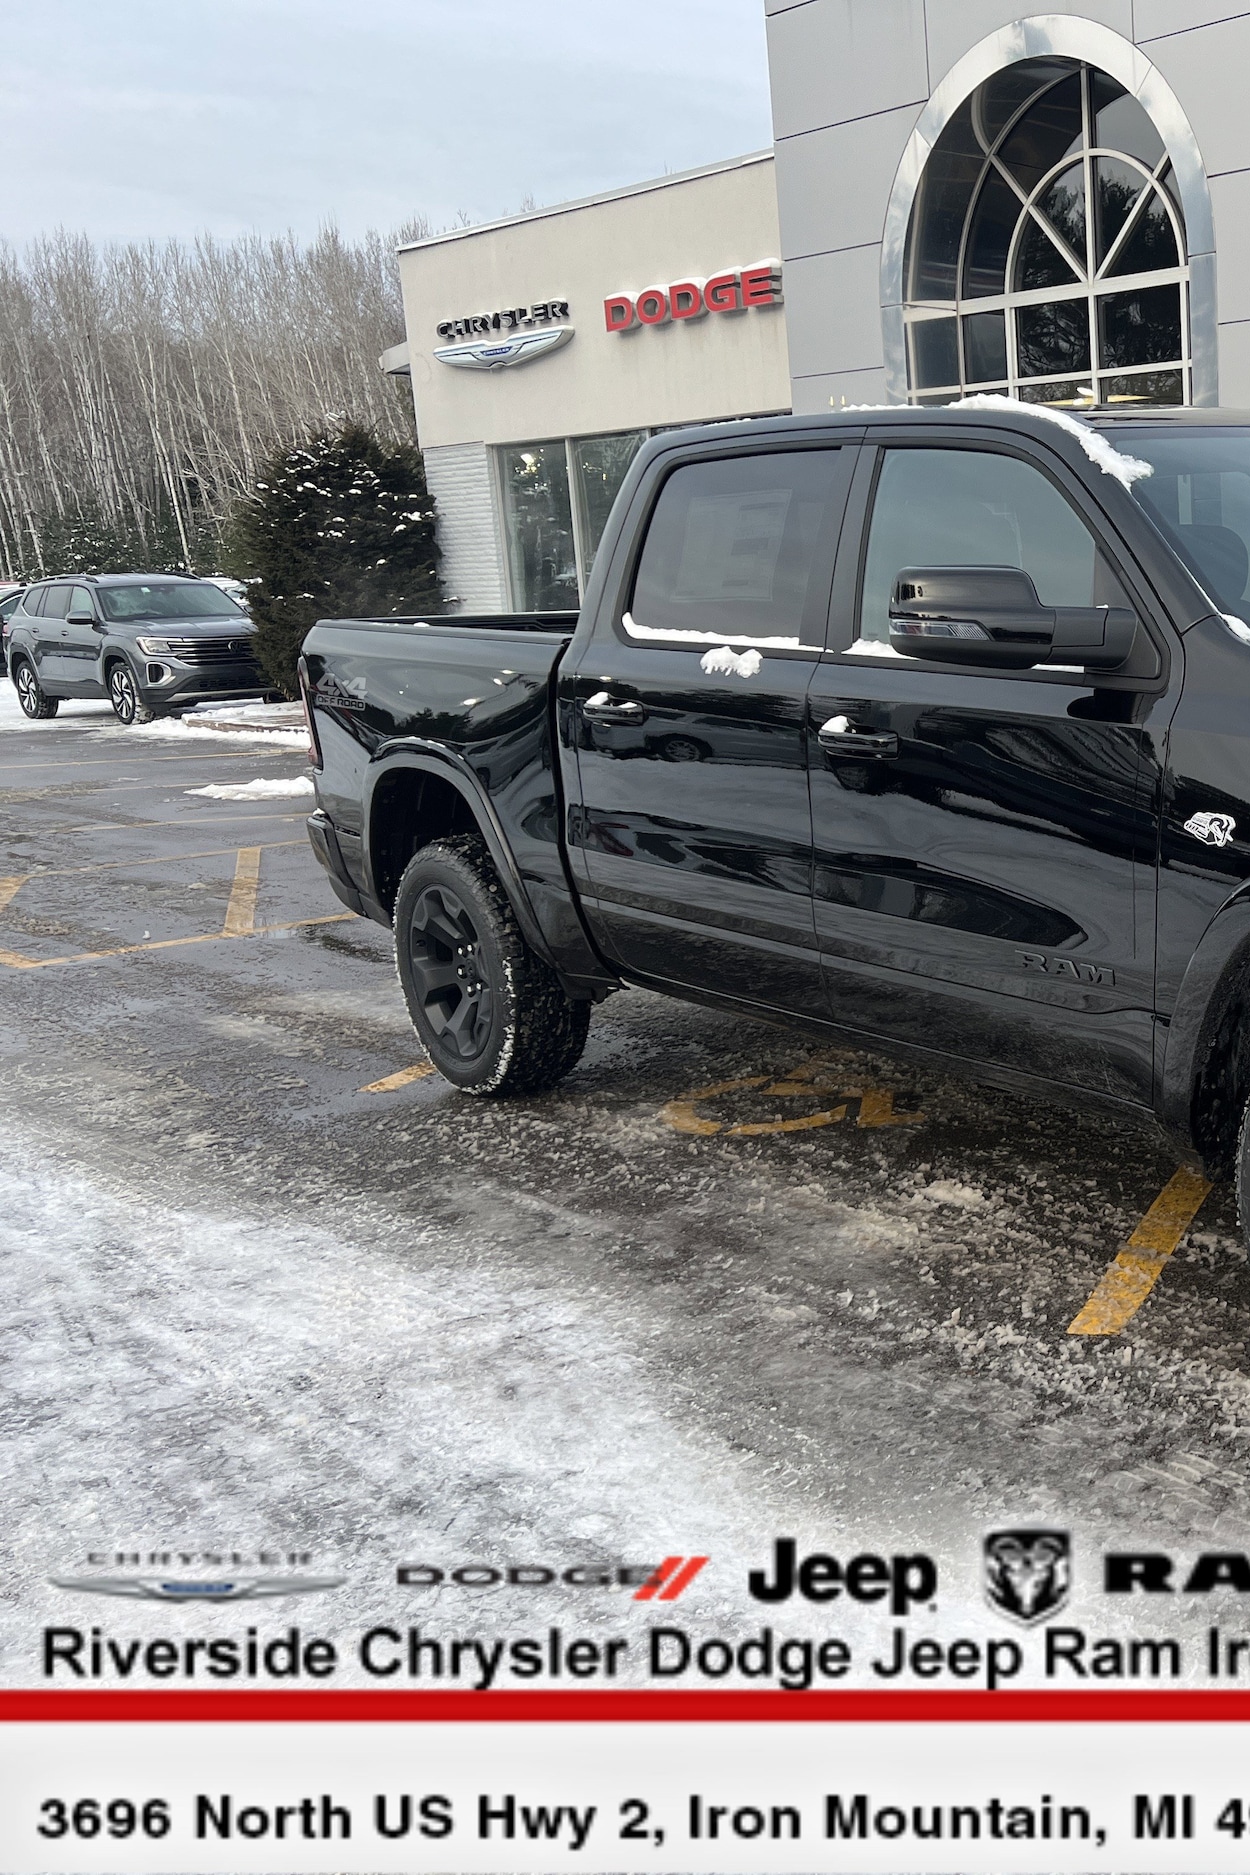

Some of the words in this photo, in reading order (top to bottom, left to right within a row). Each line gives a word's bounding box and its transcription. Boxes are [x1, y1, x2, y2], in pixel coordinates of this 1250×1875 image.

[604, 260, 783, 333] DODGE
[436, 299, 569, 340] CHRYSLER
[337, 696, 366, 709] ROAD
[1015, 949, 1116, 986] RAM
